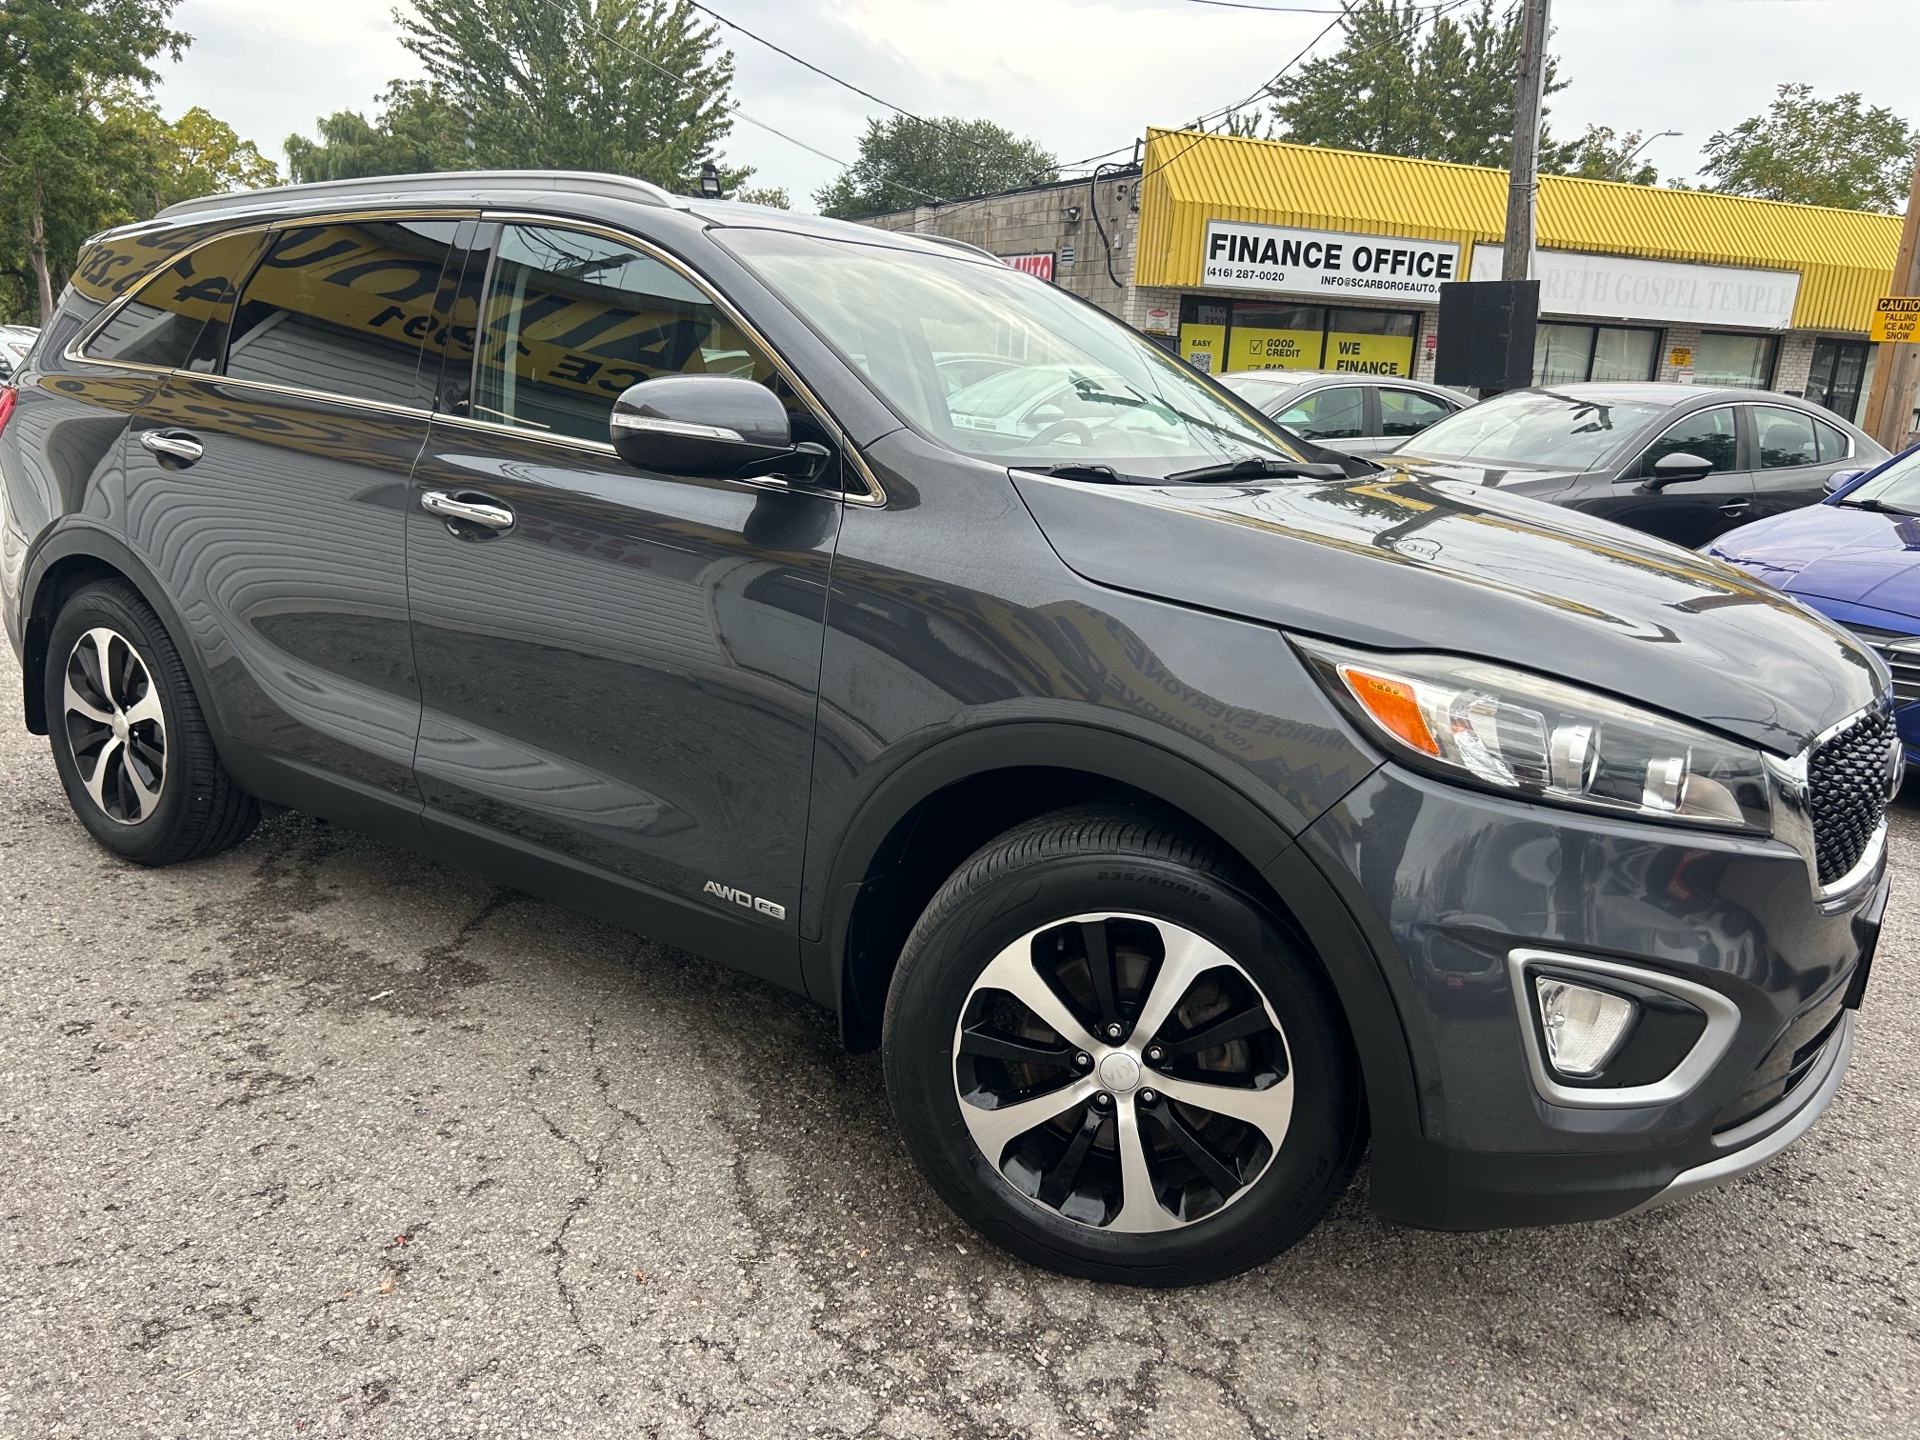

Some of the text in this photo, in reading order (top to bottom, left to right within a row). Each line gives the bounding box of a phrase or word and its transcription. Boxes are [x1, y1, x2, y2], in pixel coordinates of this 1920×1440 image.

[1209, 233, 1453, 279] FINANCE OFFICE
[1207, 266, 1285, 282] (416) 287-0020
[1615, 273, 1700, 309] GOSPEL
[1708, 281, 1792, 315] TEMPLE
[1879, 299, 1920, 311] CAUTIO
[1884, 313, 1918, 322] FALLING
[1884, 322, 1915, 332] ICE AND
[1885, 331, 1910, 340] SNOW
[1192, 339, 1212, 347] EASY
[1267, 338, 1295, 348] GOOD
[1338, 341, 1361, 356] WE
[1266, 348, 1301, 358] CREDIT
[1336, 359, 1398, 375] FINANCE
[1096, 871, 1212, 902] 235/60R18
[703, 880, 752, 909] AWD
